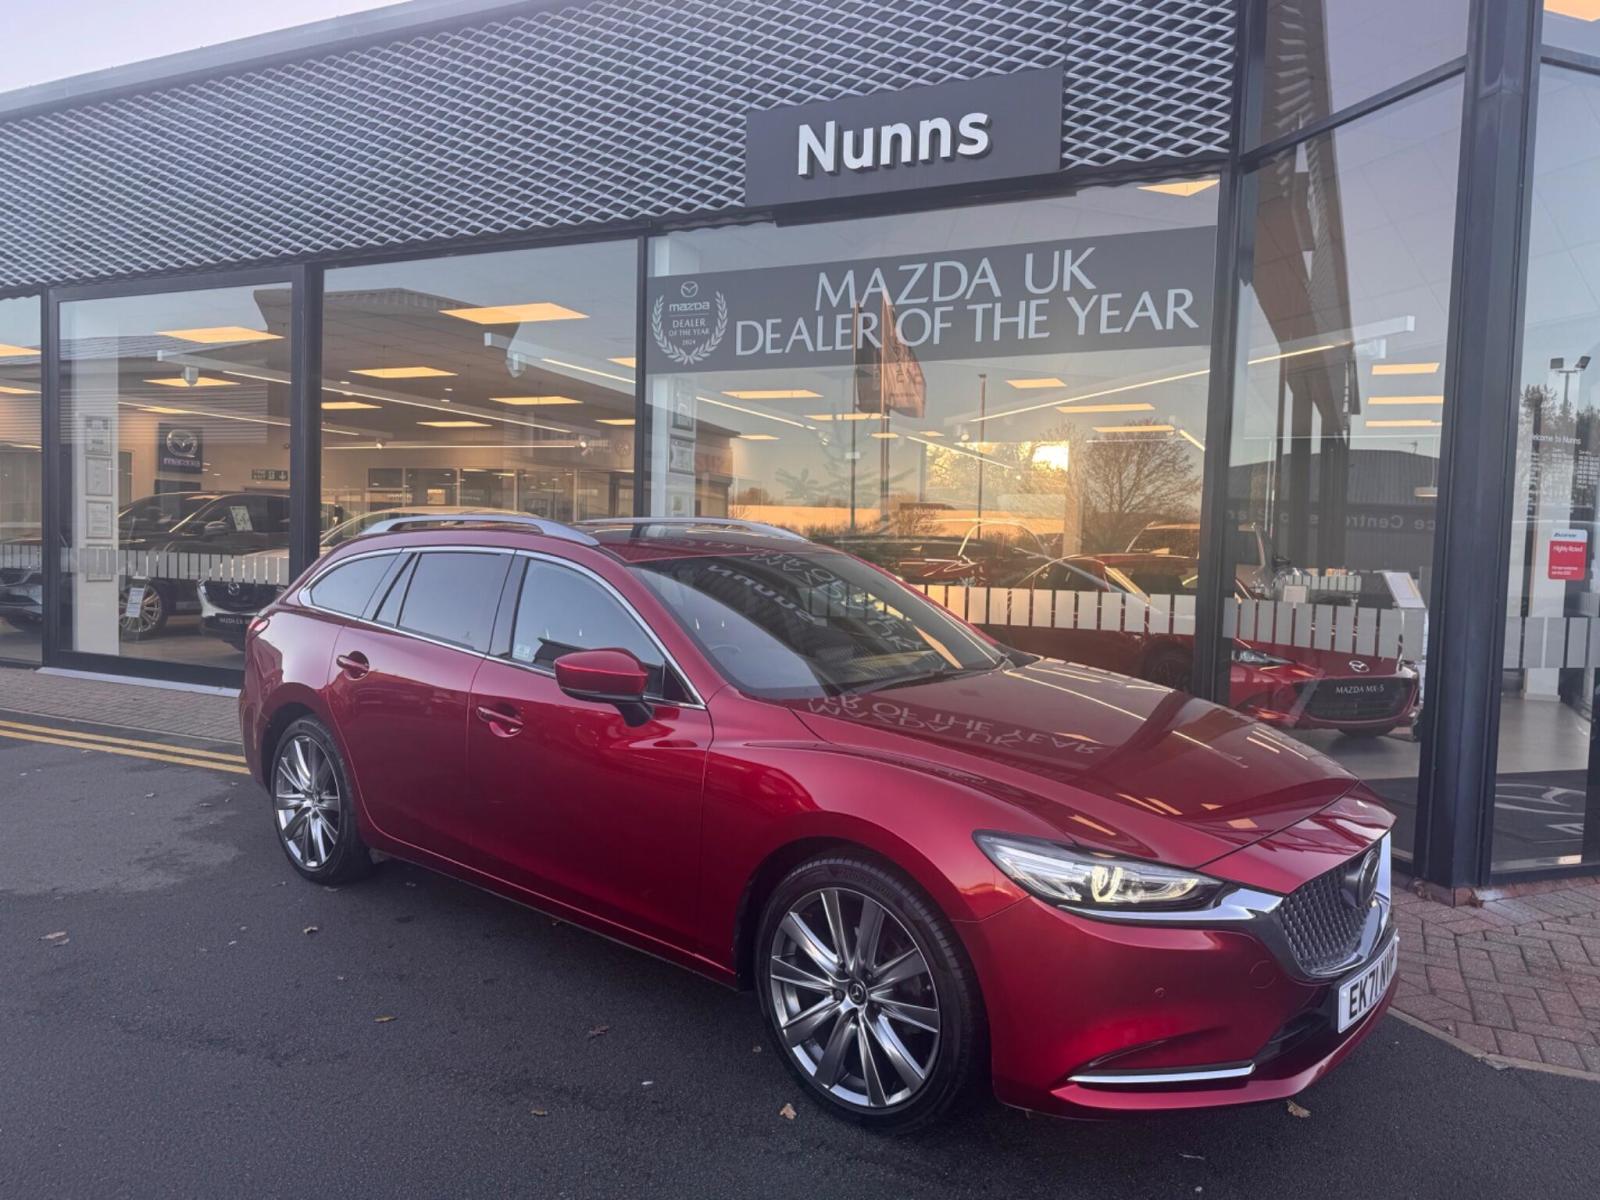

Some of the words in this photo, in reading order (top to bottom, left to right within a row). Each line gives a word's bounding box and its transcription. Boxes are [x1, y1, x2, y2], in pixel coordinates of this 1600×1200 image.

[798, 112, 990, 176] Nunns
[815, 257, 1001, 311] MAZDA
[1024, 247, 1096, 295] UK
[669, 301, 710, 312] mazda
[672, 318, 707, 329] DEALER
[735, 311, 882, 356] DEALER
[896, 306, 954, 347] OF
[966, 299, 1050, 342] THE
[1067, 288, 1199, 336] YEAR
[668, 329, 678, 337] OF
[693, 327, 710, 335] YEAR
[1335, 686, 1365, 695] MAZDA
[1366, 684, 1385, 693] MX-5
